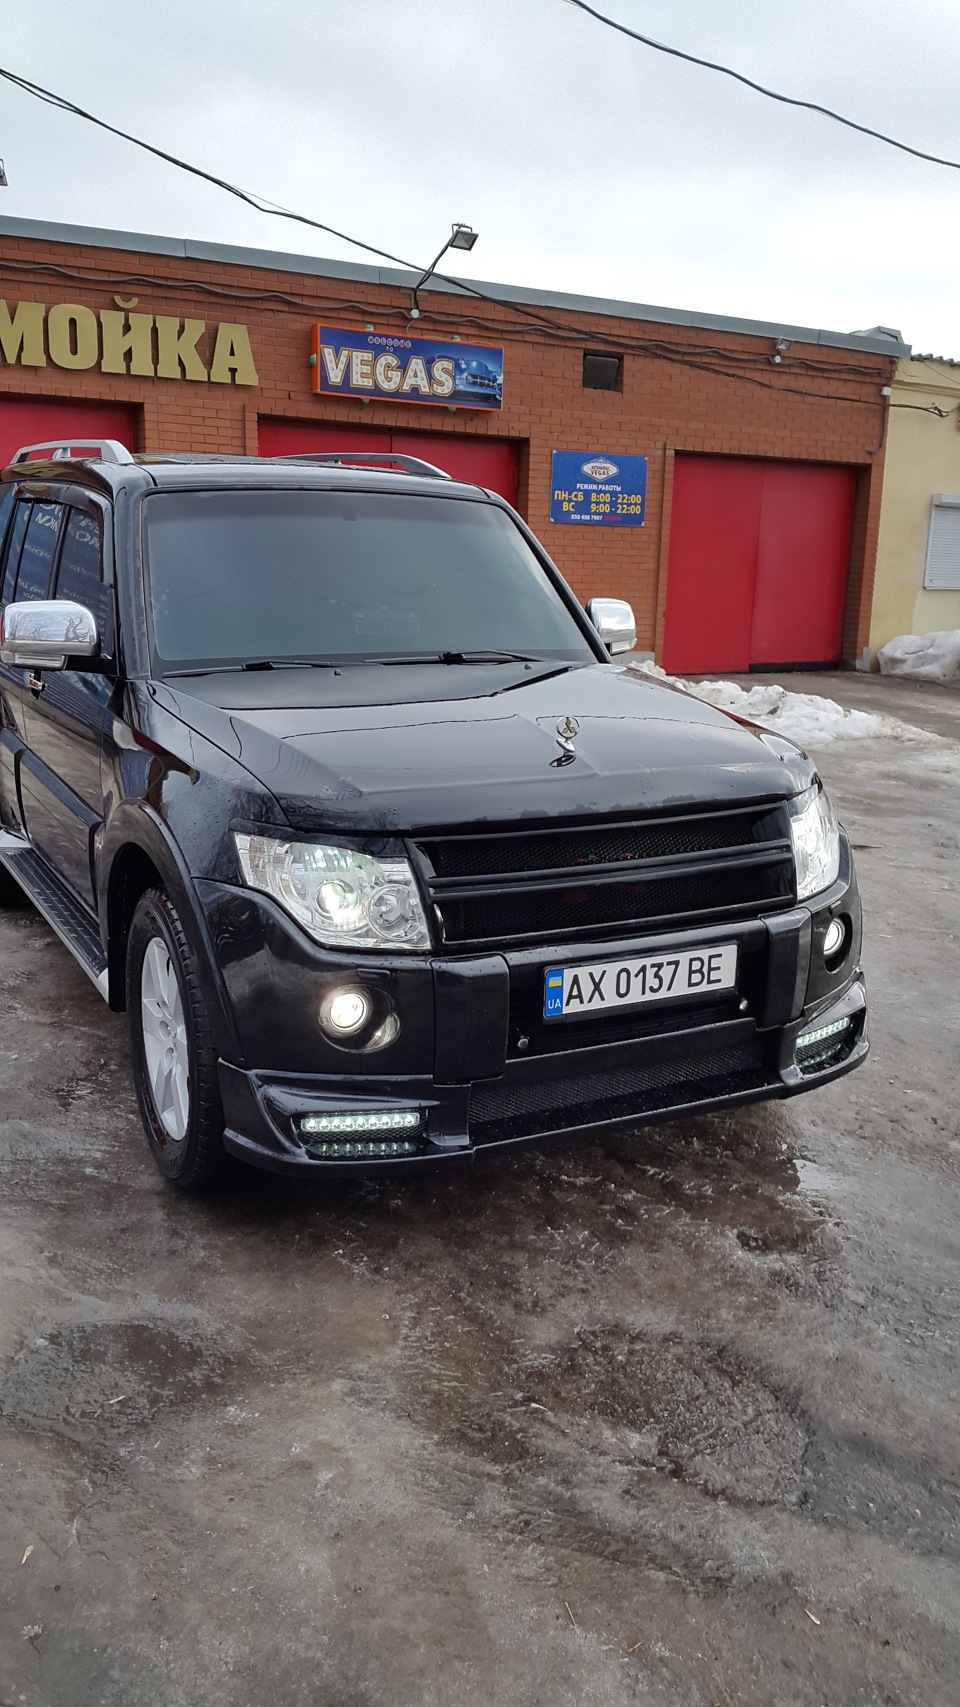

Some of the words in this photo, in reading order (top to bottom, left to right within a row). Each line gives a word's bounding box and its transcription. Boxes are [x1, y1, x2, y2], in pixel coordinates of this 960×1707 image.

[0, 296, 258, 386] МОЙКА
[368, 335, 412, 348] WELCOME
[320, 344, 456, 397] VEGAS
[576, 483, 598, 491] РЕЖИМ
[554, 490, 584, 501] ПН-СБ
[590, 493, 611, 502] 8:00
[617, 494, 642, 503] 22:00
[562, 502, 575, 512] ВС
[590, 503, 610, 513] 9:00
[616, 505, 641, 514] 22:00
[565, 969, 607, 1007] AX
[615, 959, 680, 999] 0137
[687, 953, 723, 988] BE
[547, 998, 562, 1010] UA
